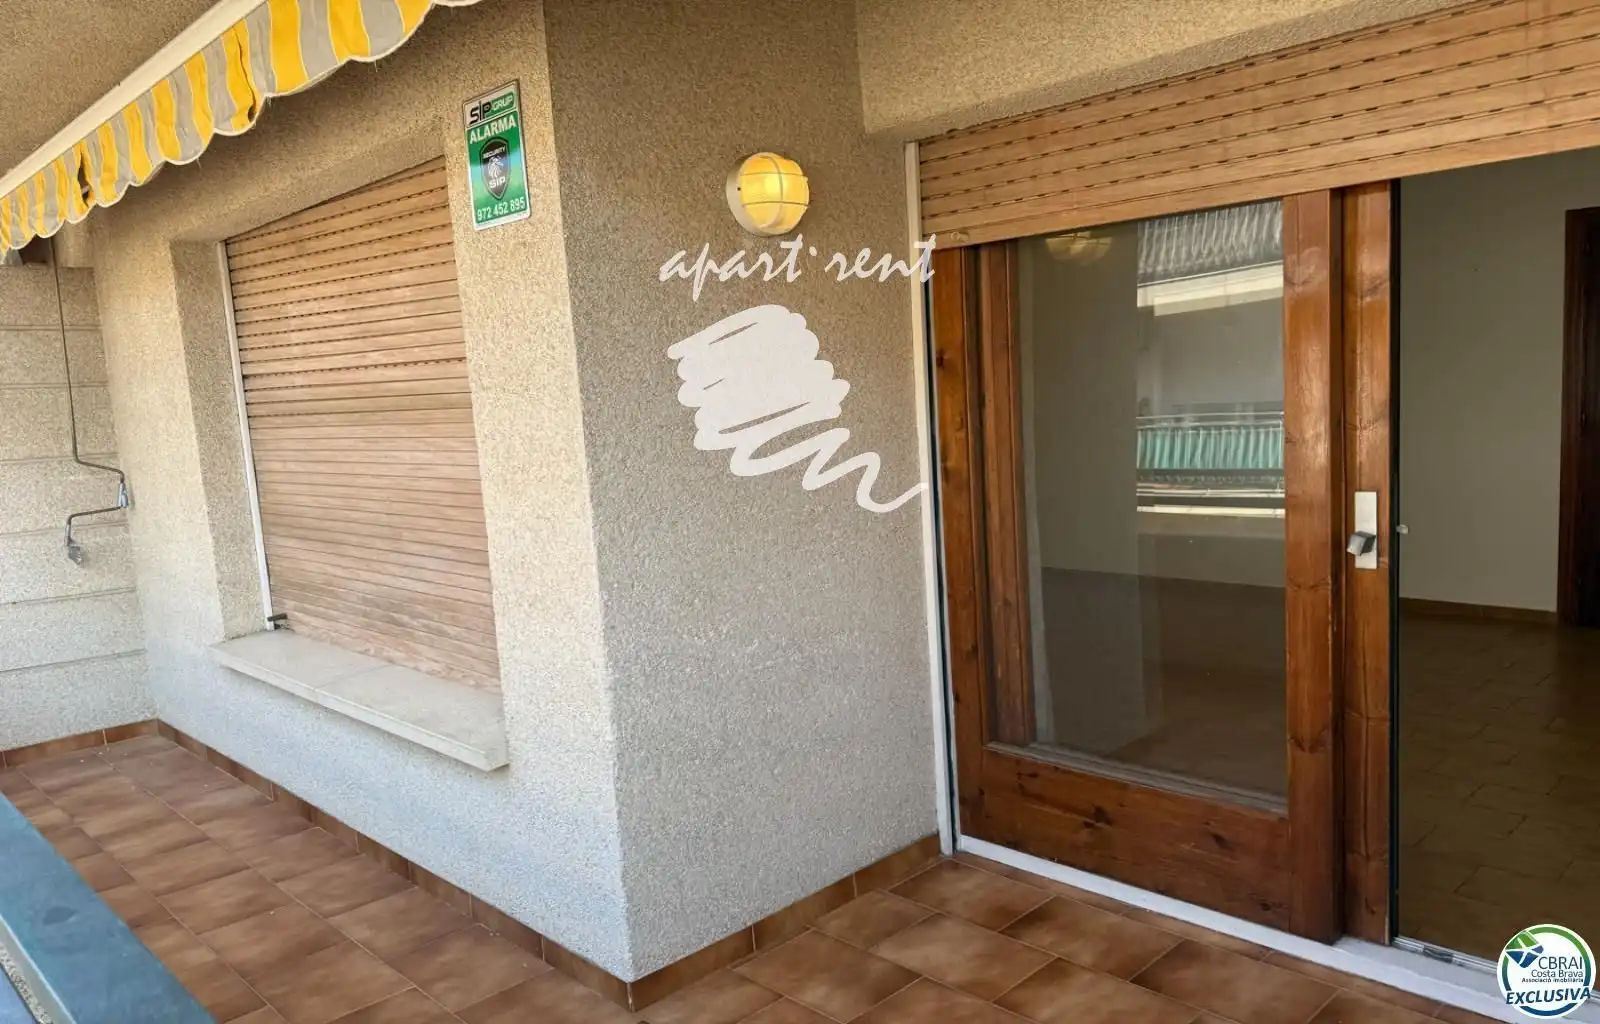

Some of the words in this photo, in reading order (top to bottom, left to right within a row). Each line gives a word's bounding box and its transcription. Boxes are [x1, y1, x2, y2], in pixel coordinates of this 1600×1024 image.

[492, 94, 514, 112] GRUP
[470, 114, 517, 145] ALARMA
[489, 176, 506, 188] SIP
[477, 206, 493, 221] 972
[493, 202, 509, 217] 452
[510, 196, 526, 212] 895
